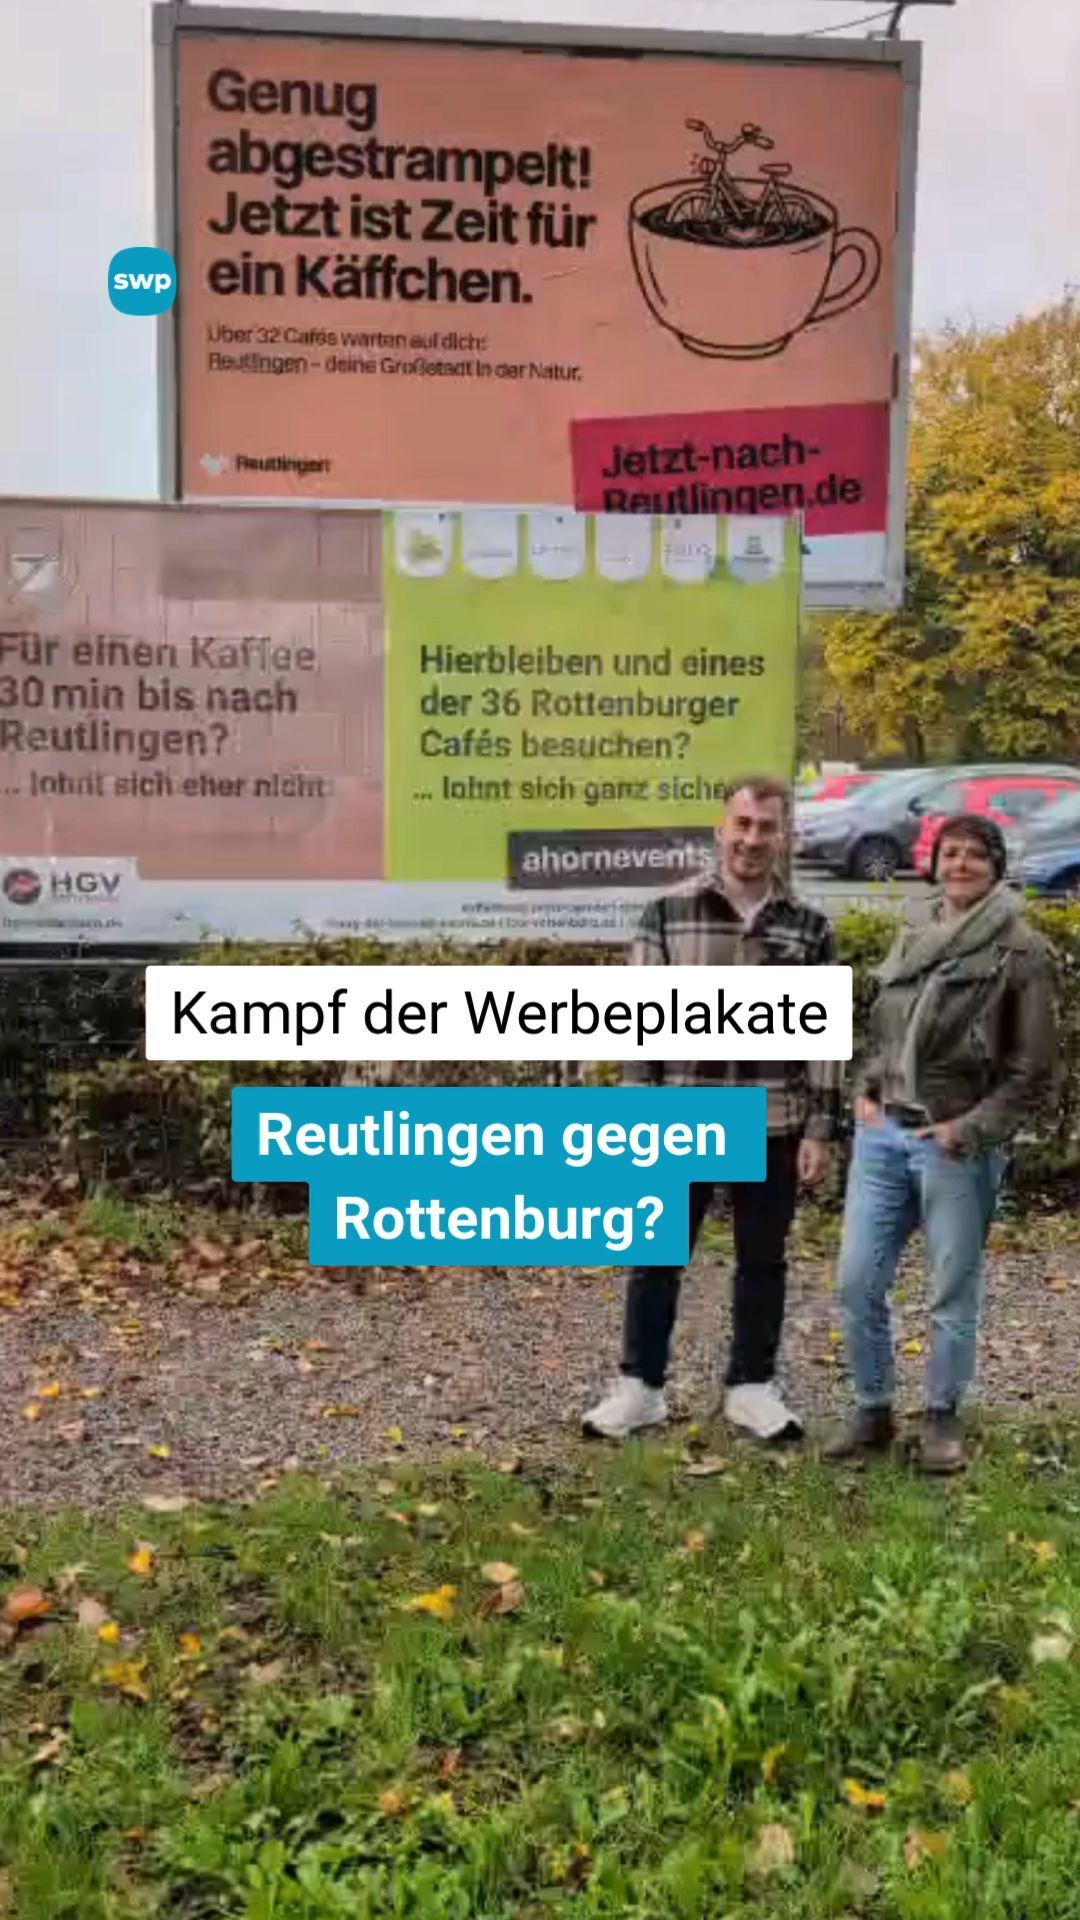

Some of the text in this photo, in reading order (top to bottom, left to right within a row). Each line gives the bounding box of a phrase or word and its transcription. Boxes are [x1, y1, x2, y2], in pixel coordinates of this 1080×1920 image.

[207, 67, 377, 132] Genug
[207, 129, 592, 196] abgestrampelt!
[207, 191, 597, 248] Jetzt ist Zeit für
[207, 251, 534, 305] ein Käffchen.
[257, 327, 281, 344] 32
[341, 331, 408, 350] warten
[409, 333, 440, 349] auf
[208, 352, 308, 375] Reutlingen
[325, 355, 377, 375] deine
[380, 357, 473, 378] Großstadt
[476, 360, 492, 377] in
[494, 362, 526, 380] der
[235, 454, 331, 478] Reutlingen
[602, 434, 821, 478] Jetzt-nach-
[0, 632, 317, 672] Für einen Kaffee
[420, 645, 765, 677] Hierbleiben und eines
[0, 675, 298, 714] 30 min bis nach
[420, 685, 740, 724] der 36 Rottenburger
[0, 718, 231, 762] Reutlingen?
[420, 729, 692, 761] Cafés besuchen?
[30, 769, 104, 797] lohnt
[114, 770, 174, 797] sich
[182, 773, 246, 798] eher
[443, 776, 511, 801] lohnt
[520, 776, 575, 800] sich
[584, 780, 648, 805] ganz
[521, 845, 713, 874] ahornevents
[51, 872, 121, 894] HGV
